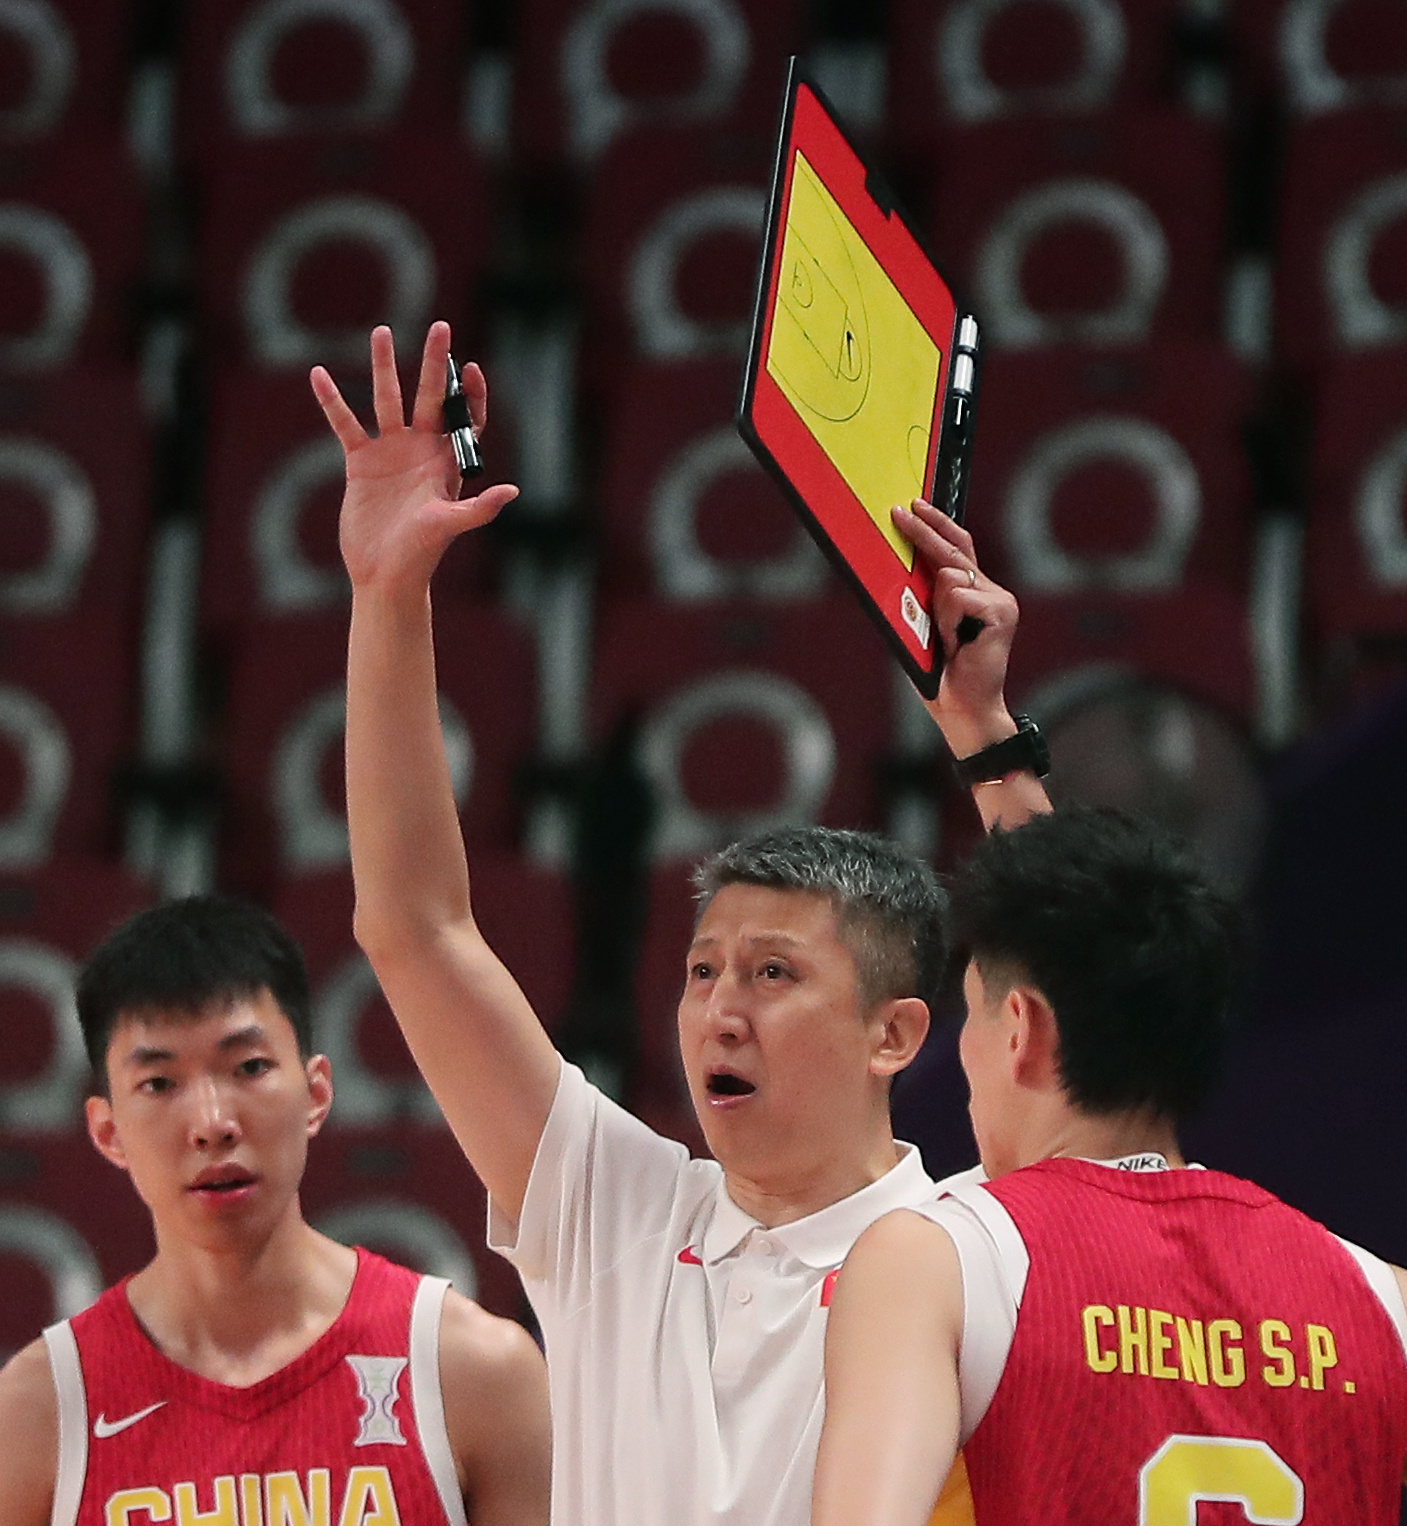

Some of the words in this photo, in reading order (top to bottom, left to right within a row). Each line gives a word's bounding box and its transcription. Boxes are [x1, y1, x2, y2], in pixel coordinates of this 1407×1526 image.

[1117, 1156, 1168, 1171] NIKE
[1081, 1304, 1247, 1388] CHENG
[1260, 1318, 1357, 1394] S.P.
